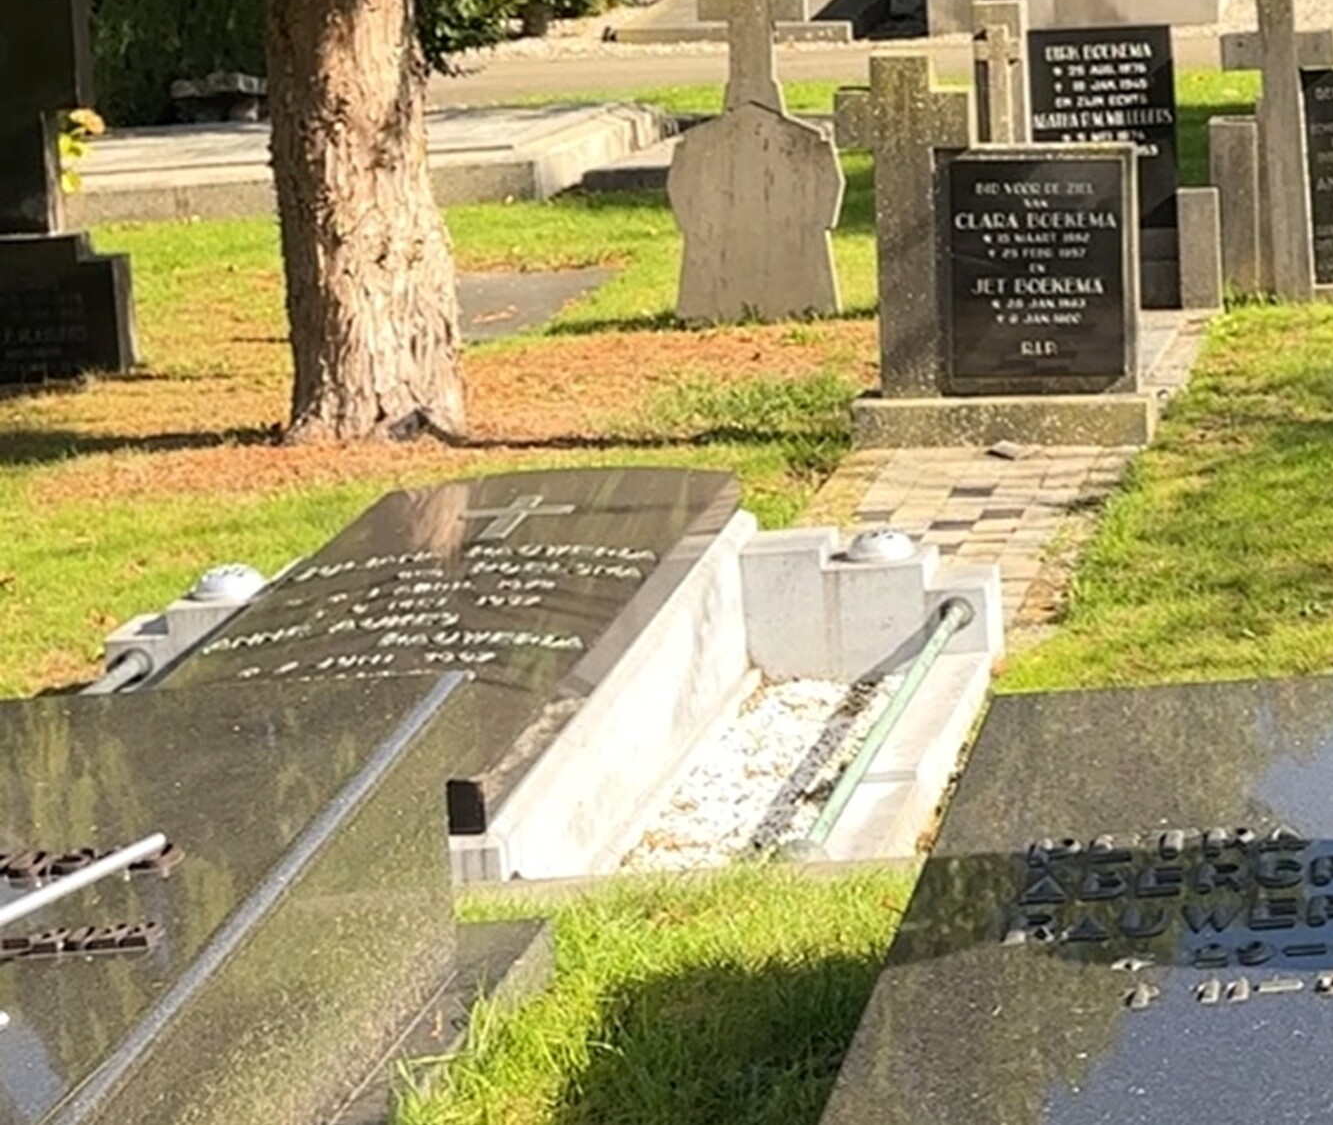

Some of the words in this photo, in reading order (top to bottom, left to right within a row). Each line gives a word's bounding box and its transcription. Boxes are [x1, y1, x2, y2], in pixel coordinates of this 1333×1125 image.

[1045, 44, 1079, 62] DIRK
[1083, 42, 1152, 61] BOEKEMA
[1004, 181, 1041, 195] VOOR
[1066, 181, 1094, 195] ZIEL
[1023, 198, 1049, 209] VAN
[954, 211, 1020, 230] CLARA
[1026, 211, 1117, 229] BOEKEMA
[1029, 263, 1046, 273] EN
[971, 278, 1006, 295] JET
[1014, 277, 1104, 295] BOEKEMA
